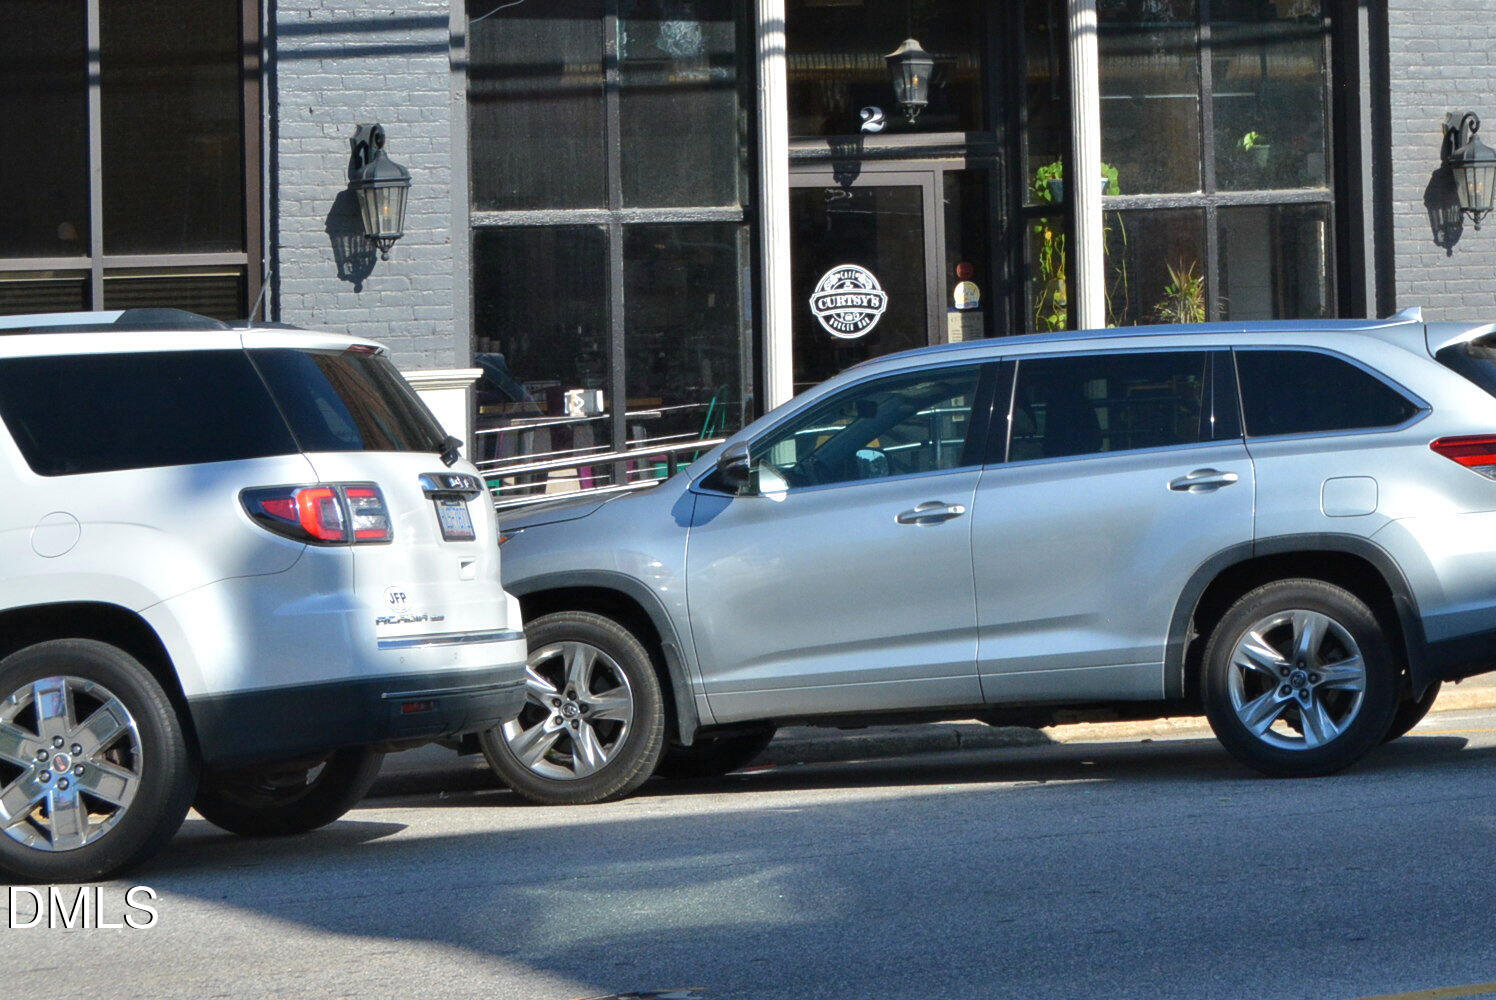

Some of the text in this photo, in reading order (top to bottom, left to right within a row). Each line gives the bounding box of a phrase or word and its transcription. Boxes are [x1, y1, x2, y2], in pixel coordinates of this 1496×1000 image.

[860, 106, 885, 132] 2
[818, 294, 880, 310] CURTSY'S
[389, 592, 407, 604] JFP
